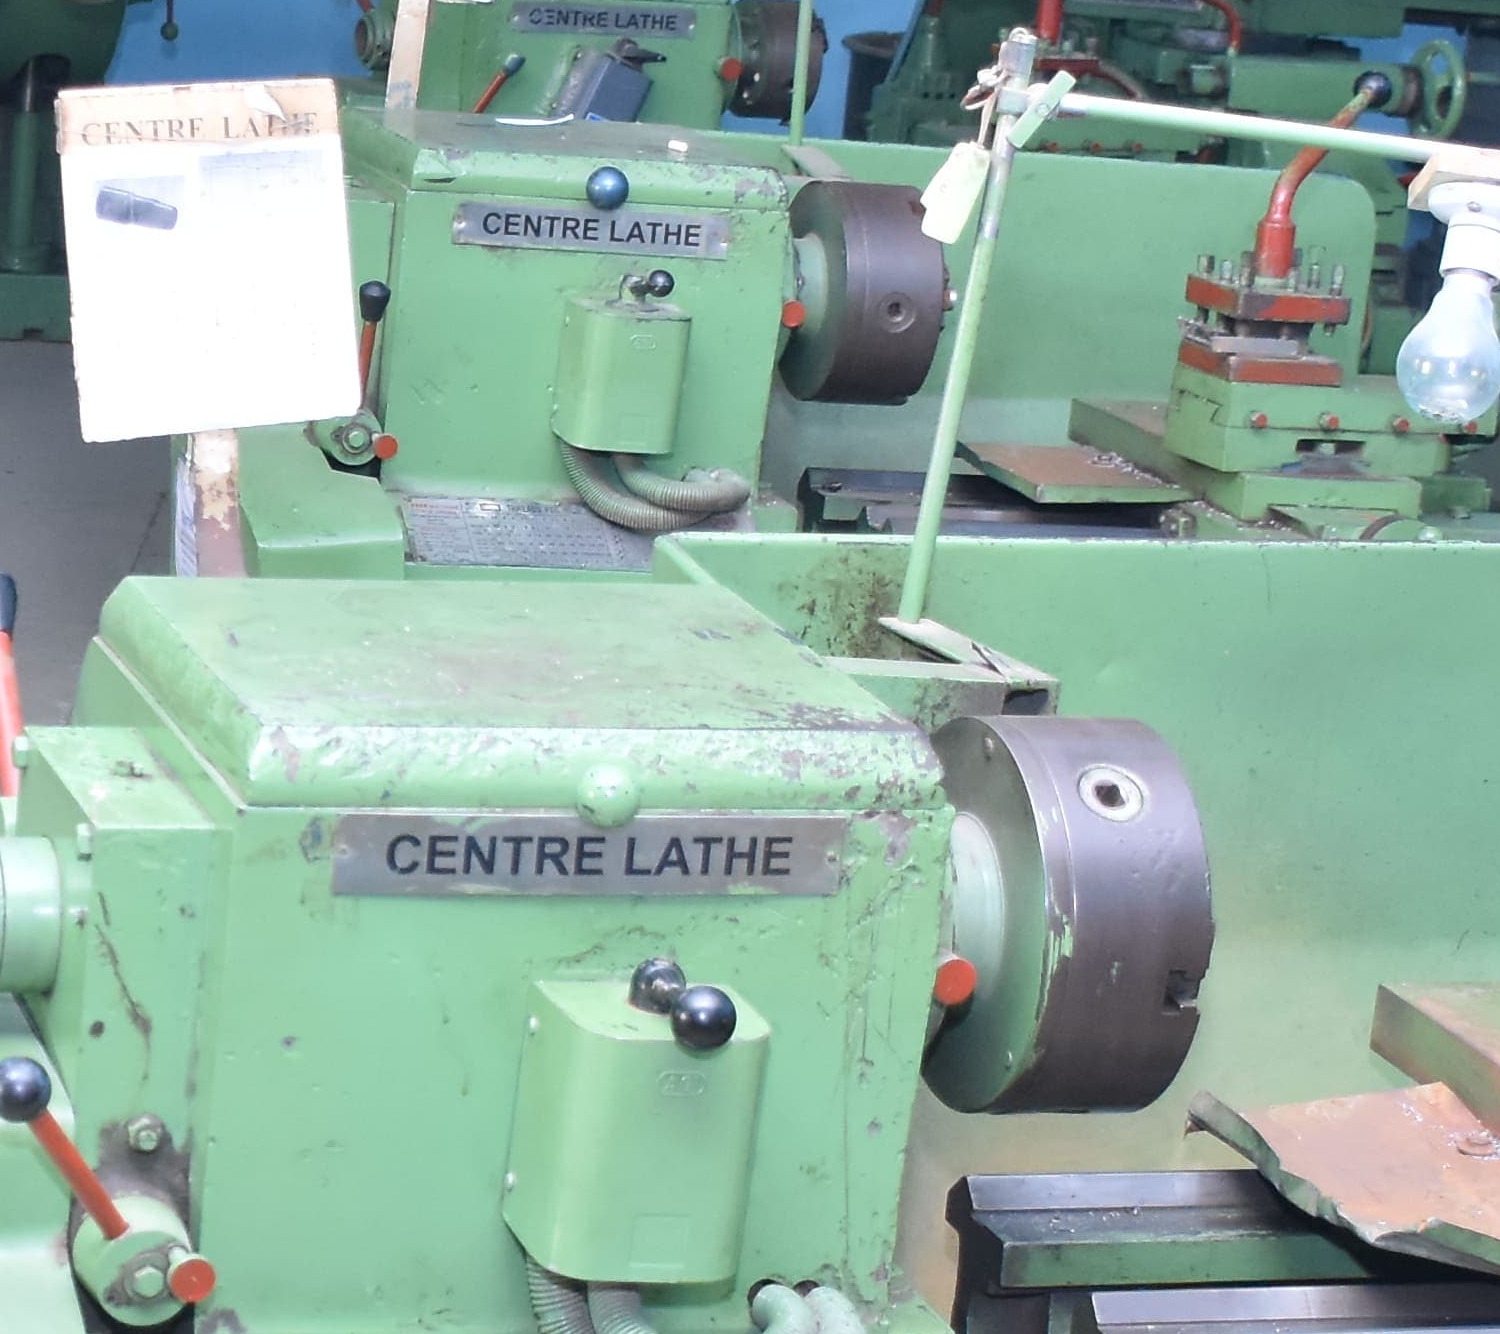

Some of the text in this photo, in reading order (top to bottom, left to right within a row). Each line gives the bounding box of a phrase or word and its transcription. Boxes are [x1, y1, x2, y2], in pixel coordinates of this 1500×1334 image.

[528, 7, 678, 32] CENTRE LATHE
[81, 116, 205, 147] CENTRE
[481, 211, 703, 247] CENTRE LATHE
[386, 833, 794, 877] CENTRE LATHE
